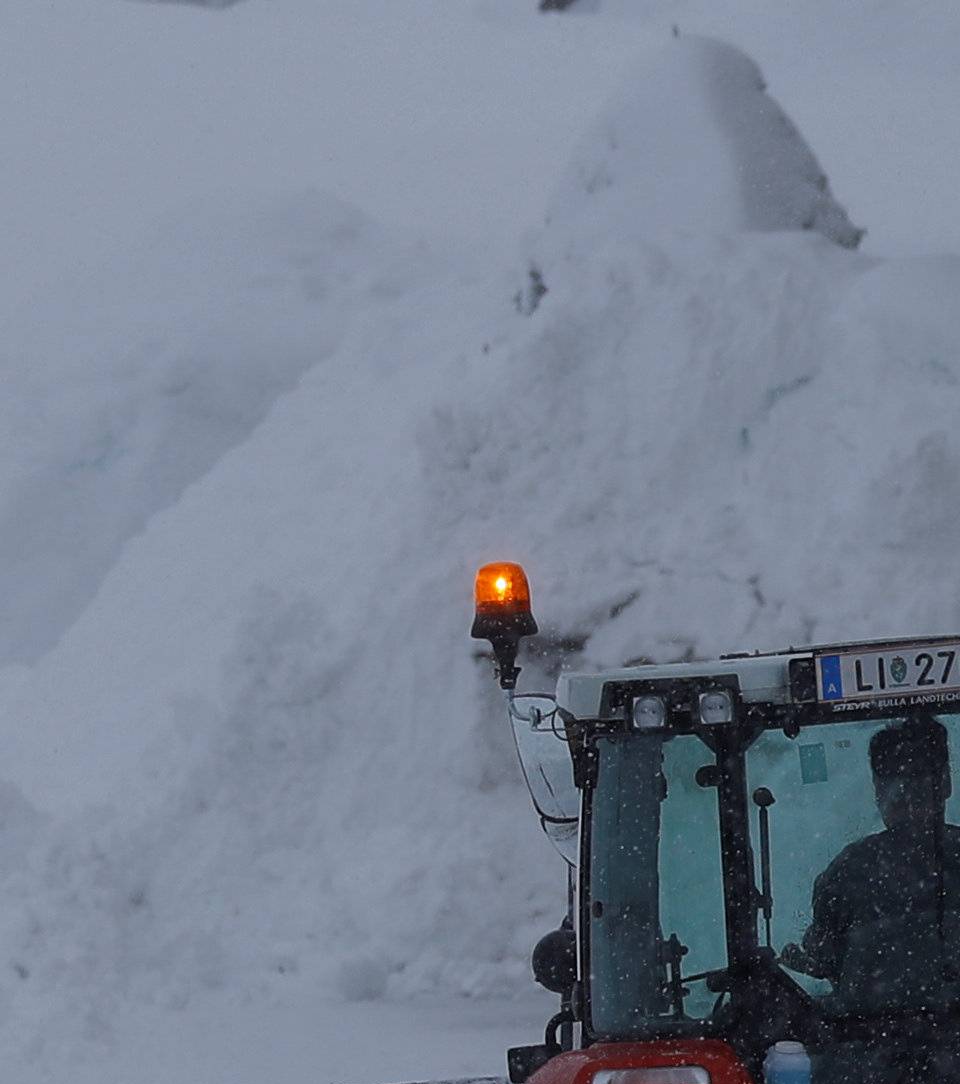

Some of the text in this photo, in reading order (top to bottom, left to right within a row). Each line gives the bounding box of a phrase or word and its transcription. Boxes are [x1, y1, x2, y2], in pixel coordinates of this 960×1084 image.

[855, 657, 885, 692] LI
[827, 683, 836, 693] A
[832, 702, 871, 712] STEYR
